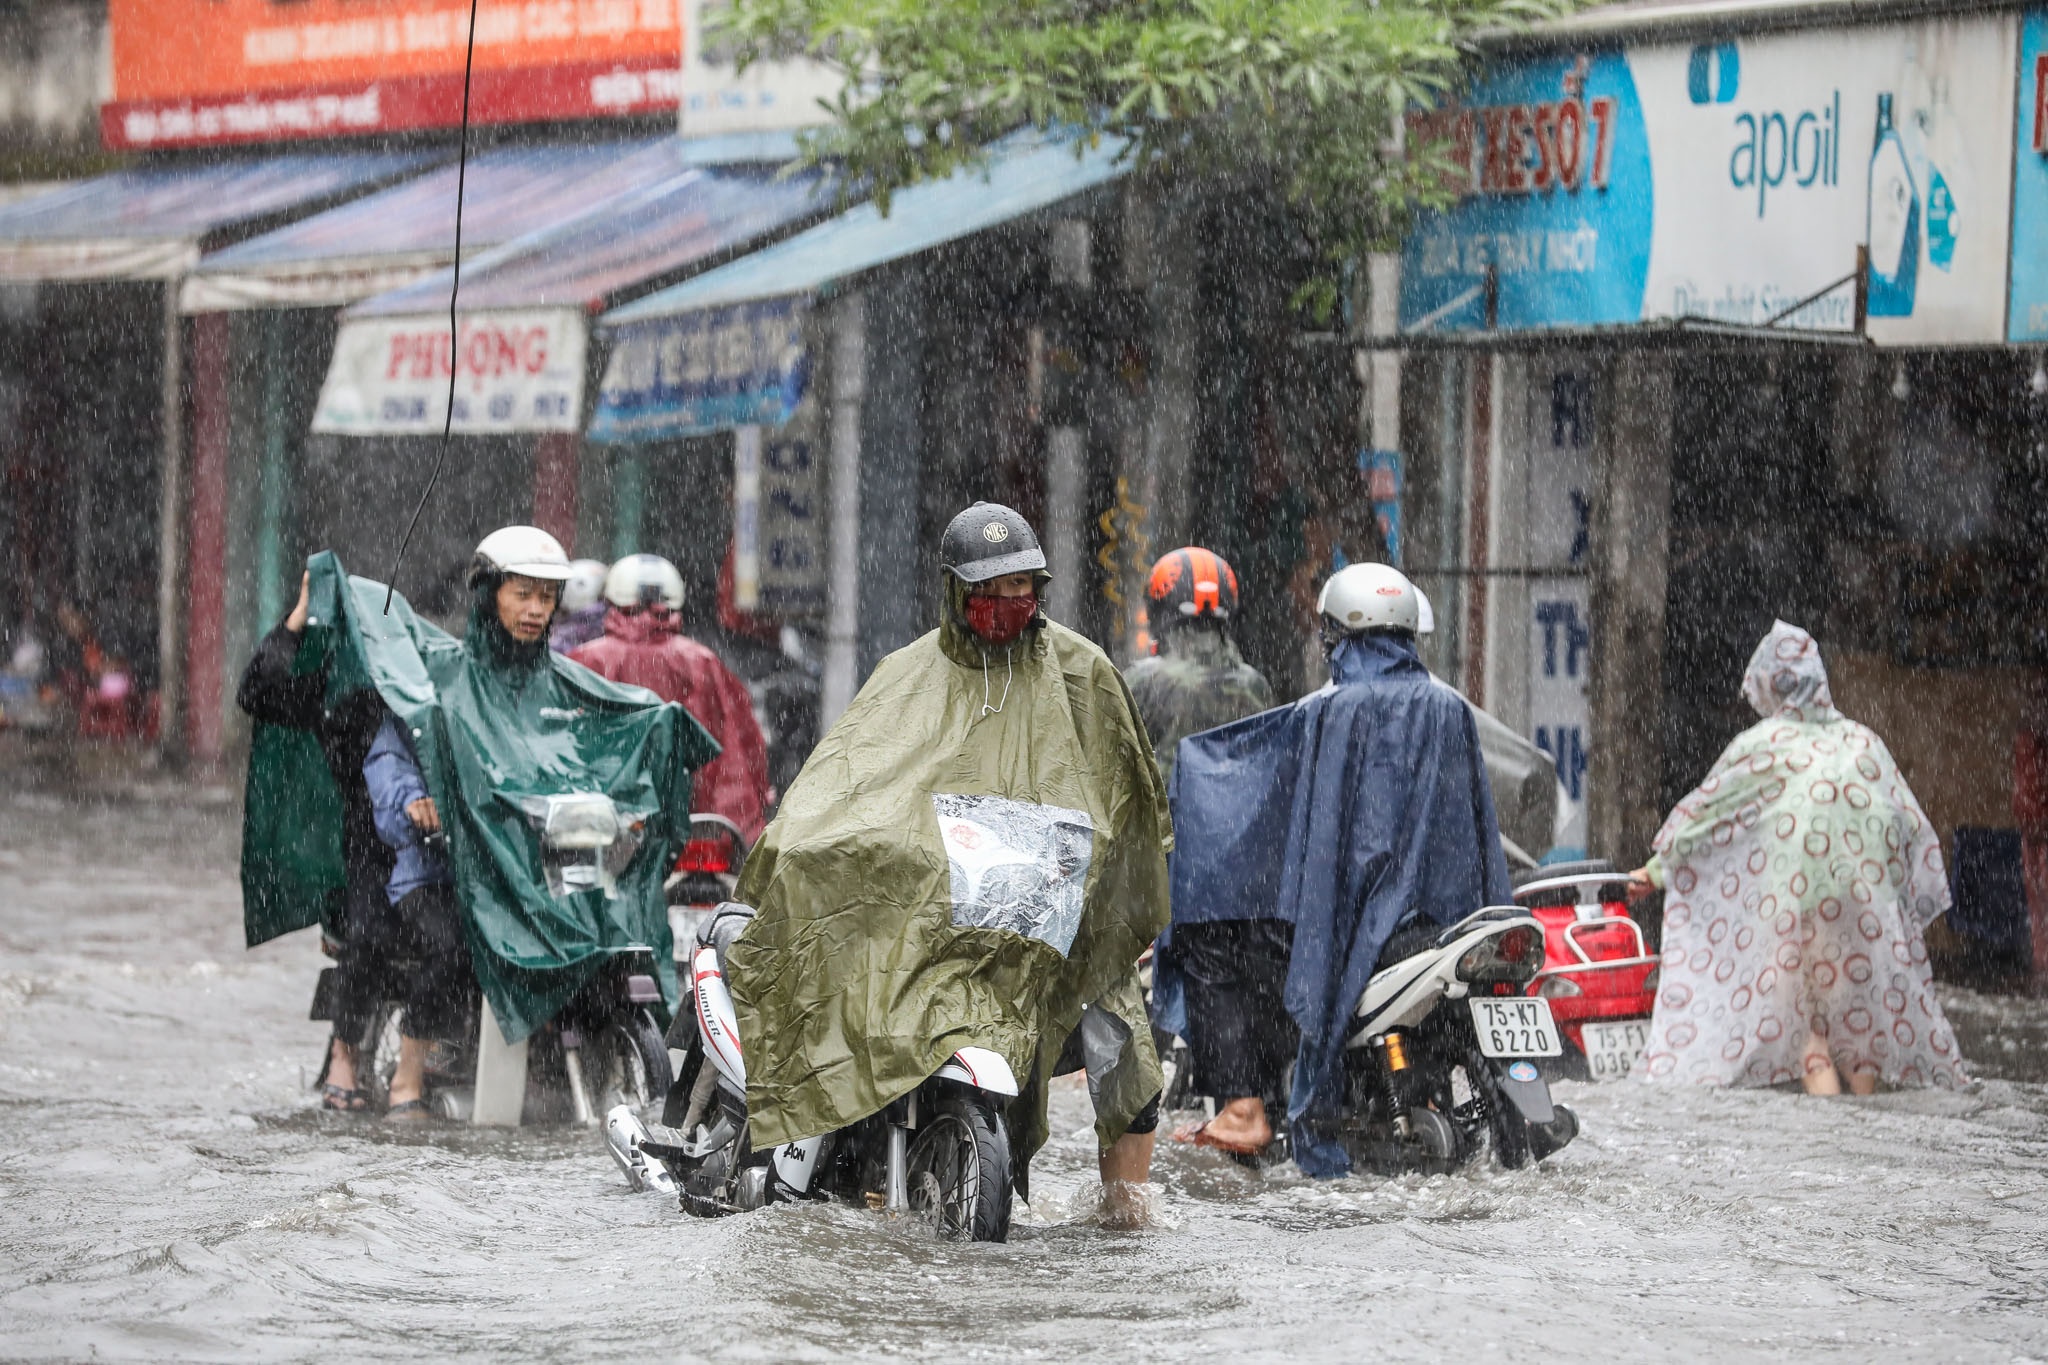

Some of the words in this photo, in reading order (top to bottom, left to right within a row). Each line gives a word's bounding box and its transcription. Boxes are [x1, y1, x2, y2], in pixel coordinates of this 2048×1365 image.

[1730, 89, 1840, 219] apoil
[985, 523, 1006, 541] NIKE
[698, 985, 721, 1036] JUPITER
[1482, 1003, 1538, 1026] 75-K7
[1490, 1028, 1549, 1052] 6220
[1594, 1024, 1646, 1049] 75-F1
[1592, 1050, 1642, 1075] 036
